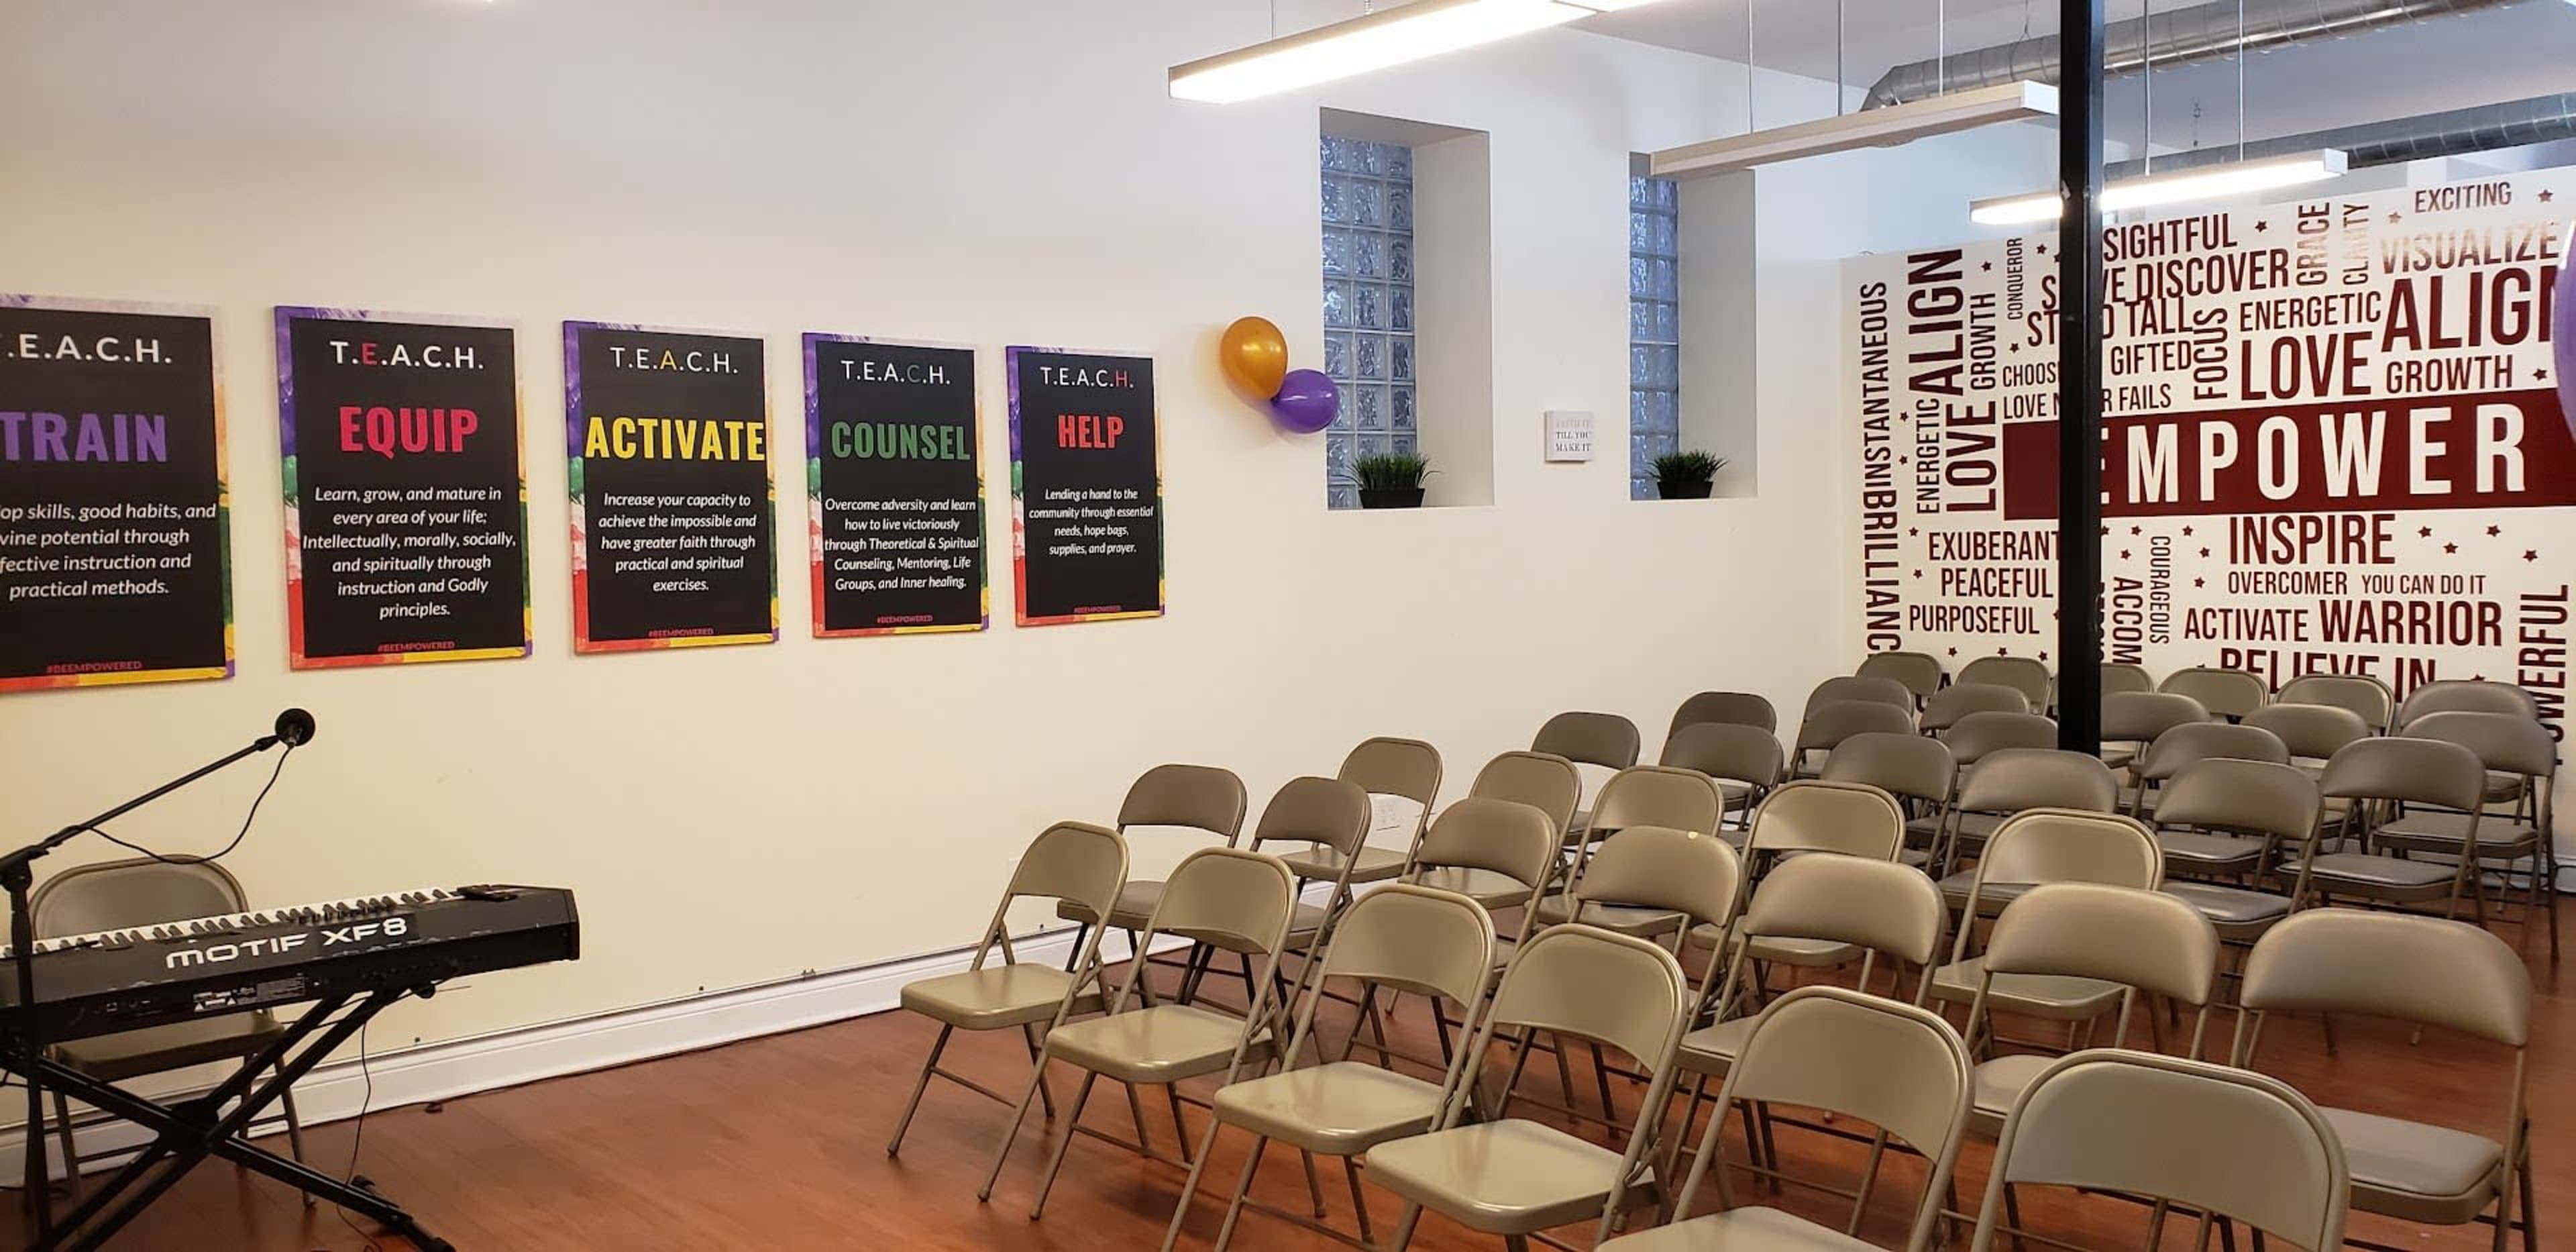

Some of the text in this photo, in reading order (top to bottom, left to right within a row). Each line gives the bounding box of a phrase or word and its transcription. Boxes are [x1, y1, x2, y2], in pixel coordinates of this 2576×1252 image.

[2415, 182, 2512, 213] EXCITING
[2102, 213, 2238, 262] SIGHTFUL
[2296, 202, 2330, 286] GRACE
[2342, 204, 2369, 285] CLTY
[2379, 220, 2560, 274] VISUALIZE
[2006, 237, 2023, 319] CONQUEROR
[2137, 248, 2290, 302] DISCOVER
[1907, 248, 1964, 397] ALIGN
[2027, 296, 2194, 347] STD TALL
[2240, 291, 2381, 332] ENERGETIC
[0, 333, 172, 363] .E.A.C.H.
[329, 341, 484, 369] T.E.A.C.H.
[1970, 293, 1996, 390] GROWTH
[2193, 307, 2229, 400] FOCUS
[610, 347, 739, 374] T.E.A.C.H.
[841, 360, 951, 384] T.E.A.C.H.
[2110, 341, 2192, 376] GIFTED
[2241, 331, 2373, 402] LOVE
[1040, 366, 1134, 388] T.E.A.C.H.
[1860, 282, 1892, 488] INSTANTANEOUS
[2002, 360, 2061, 387] CHOOS
[2386, 354, 2513, 395] GROWTH
[2004, 393, 2048, 419] LOVE
[2118, 383, 2172, 411] FAILS
[0, 411, 168, 462] TRAIN
[339, 406, 478, 459] EQUIP
[585, 416, 765, 461] ACTIVATE
[831, 421, 971, 460] COUNSEL
[1058, 414, 1124, 449] HELP
[1556, 443, 1592, 451] MAKE IT
[1916, 398, 1940, 515] ENERGETIC
[1945, 401, 1997, 513] LOVE
[315, 486, 502, 504] Learn, grow, and mature in
[604, 493, 751, 508] Increase your capacity to
[825, 499, 976, 513] Overcome adversity and learn
[1045, 488, 1138, 502] Lending a hand to the
[0, 503, 217, 522] op skills, good habits, and
[333, 509, 488, 527] every area of your life;
[598, 514, 757, 529] achieve the impossible and
[845, 519, 960, 532] how to live victoriously
[1029, 506, 1154, 519] community through essential
[0, 528, 190, 547] vine potential through
[303, 532, 517, 550] Intellectually, morally, socially,
[601, 535, 756, 551] have greater faith through
[825, 537, 979, 551] through Theoretical & Spiritual
[1055, 525, 1129, 537] needs, hope bags,
[1929, 530, 2061, 561] EXUBERANT
[2229, 513, 2396, 564] INSPIRE
[0, 553, 192, 574] fective instruction and
[332, 555, 492, 573] and spiritually through
[615, 556, 744, 572] practical and spiritual
[1049, 543, 1137, 556] supplies, and prayer.
[835, 557, 971, 572] Counseling, Mentoring, Life
[1862, 489, 1902, 657] BRILLIANC
[9, 579, 169, 601] practical methods.
[337, 578, 489, 596] instruction and Godly
[653, 579, 709, 592] exercises.
[835, 576, 967, 591] Groups, and Inner healing.
[1941, 568, 2053, 598] PEACEFUL
[2149, 536, 2171, 645] COURAGEOUS
[2228, 571, 2348, 595] OVERCOMER
[2361, 575, 2487, 594] YOU CAN DO IT
[379, 603, 451, 619] principles.
[1909, 605, 2040, 634] PURPOSEFUL
[2112, 576, 2143, 665] ACCOM
[2184, 599, 2502, 647] ACTIVATE WARRIOR
[165, 917, 407, 970] MOTIF XF8
